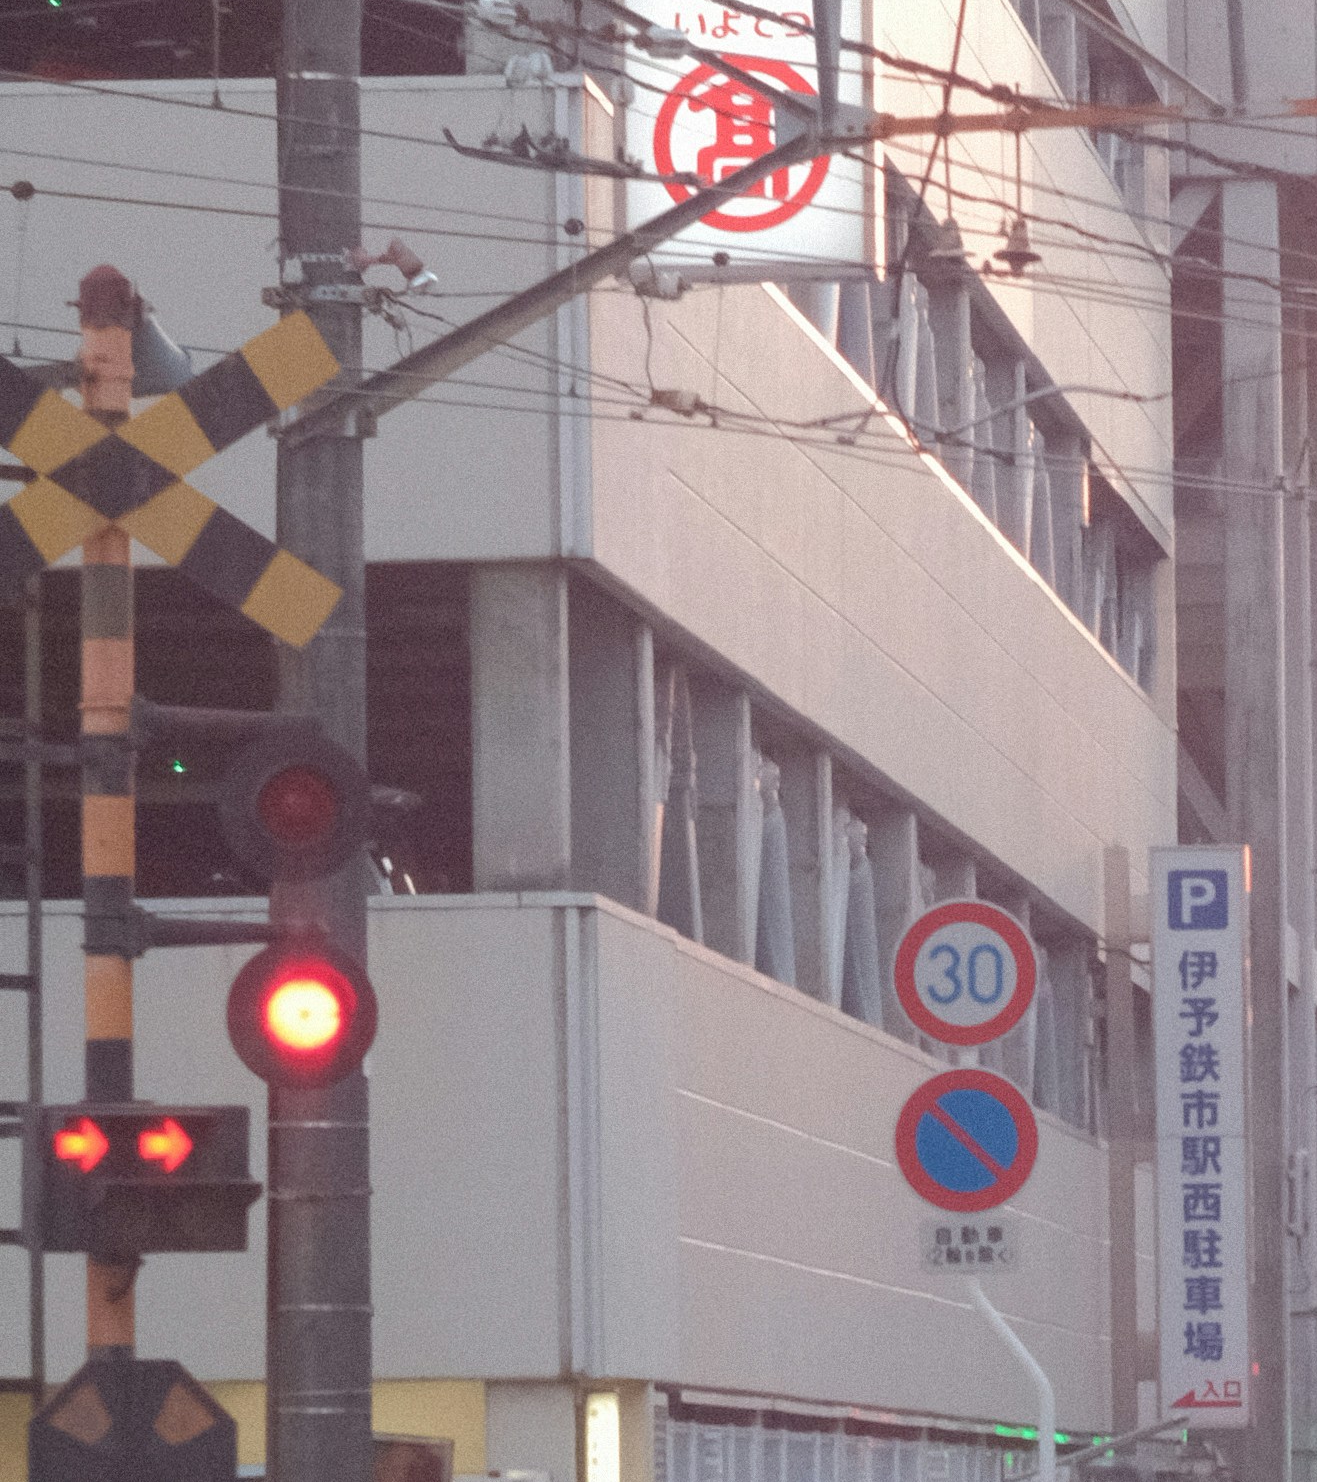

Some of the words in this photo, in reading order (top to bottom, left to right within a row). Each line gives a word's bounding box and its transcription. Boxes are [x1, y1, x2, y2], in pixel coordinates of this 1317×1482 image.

[1181, 878, 1217, 924] P
[927, 942, 1004, 1006] 30
[1178, 950, 1224, 1362] 伊予鉄市駅西駐車場
[1202, 1380, 1241, 1399] 入口
